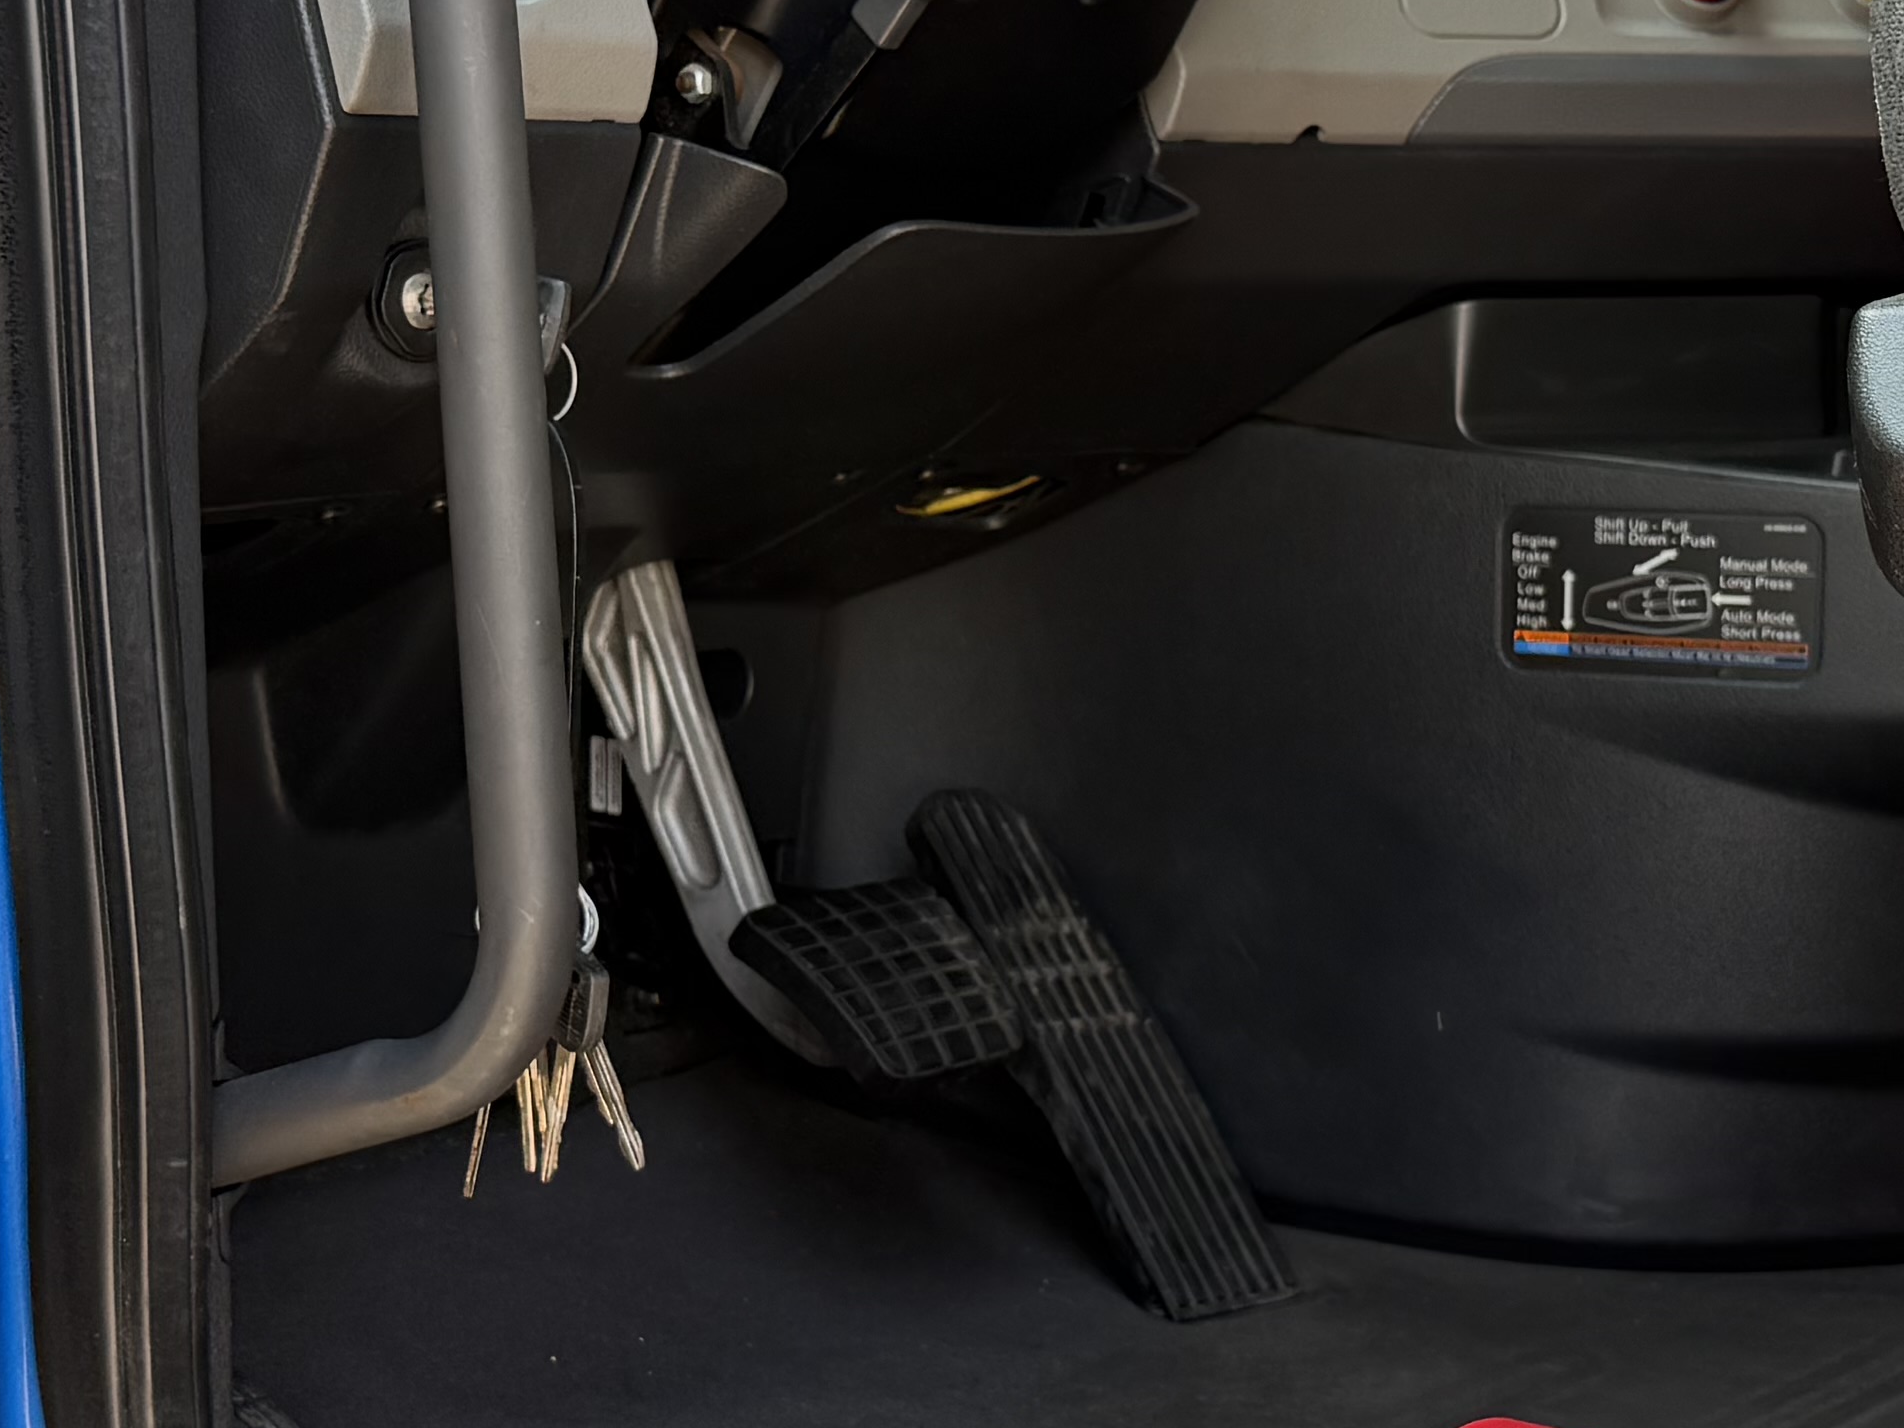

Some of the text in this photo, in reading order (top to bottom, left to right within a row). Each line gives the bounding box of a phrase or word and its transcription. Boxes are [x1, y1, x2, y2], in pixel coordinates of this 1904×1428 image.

[1595, 515, 1626, 531] Shift
[1628, 518, 1649, 533] Up
[1662, 518, 1689, 533] Pull
[1512, 532, 1558, 549] Engine
[1594, 531, 1626, 545] Shift
[1628, 532, 1668, 546] Down
[1680, 533, 1717, 548] Push
[1512, 548, 1551, 564] Brake
[1517, 564, 1539, 580] Off
[1719, 556, 1808, 574] Manual Mode
[1517, 581, 1545, 596] Low
[1719, 576, 1793, 592] Long Press
[1517, 597, 1546, 612] Med
[1517, 613, 1547, 629] High
[1721, 608, 1795, 624] Auto Mode
[1721, 624, 1802, 641] Short Press
